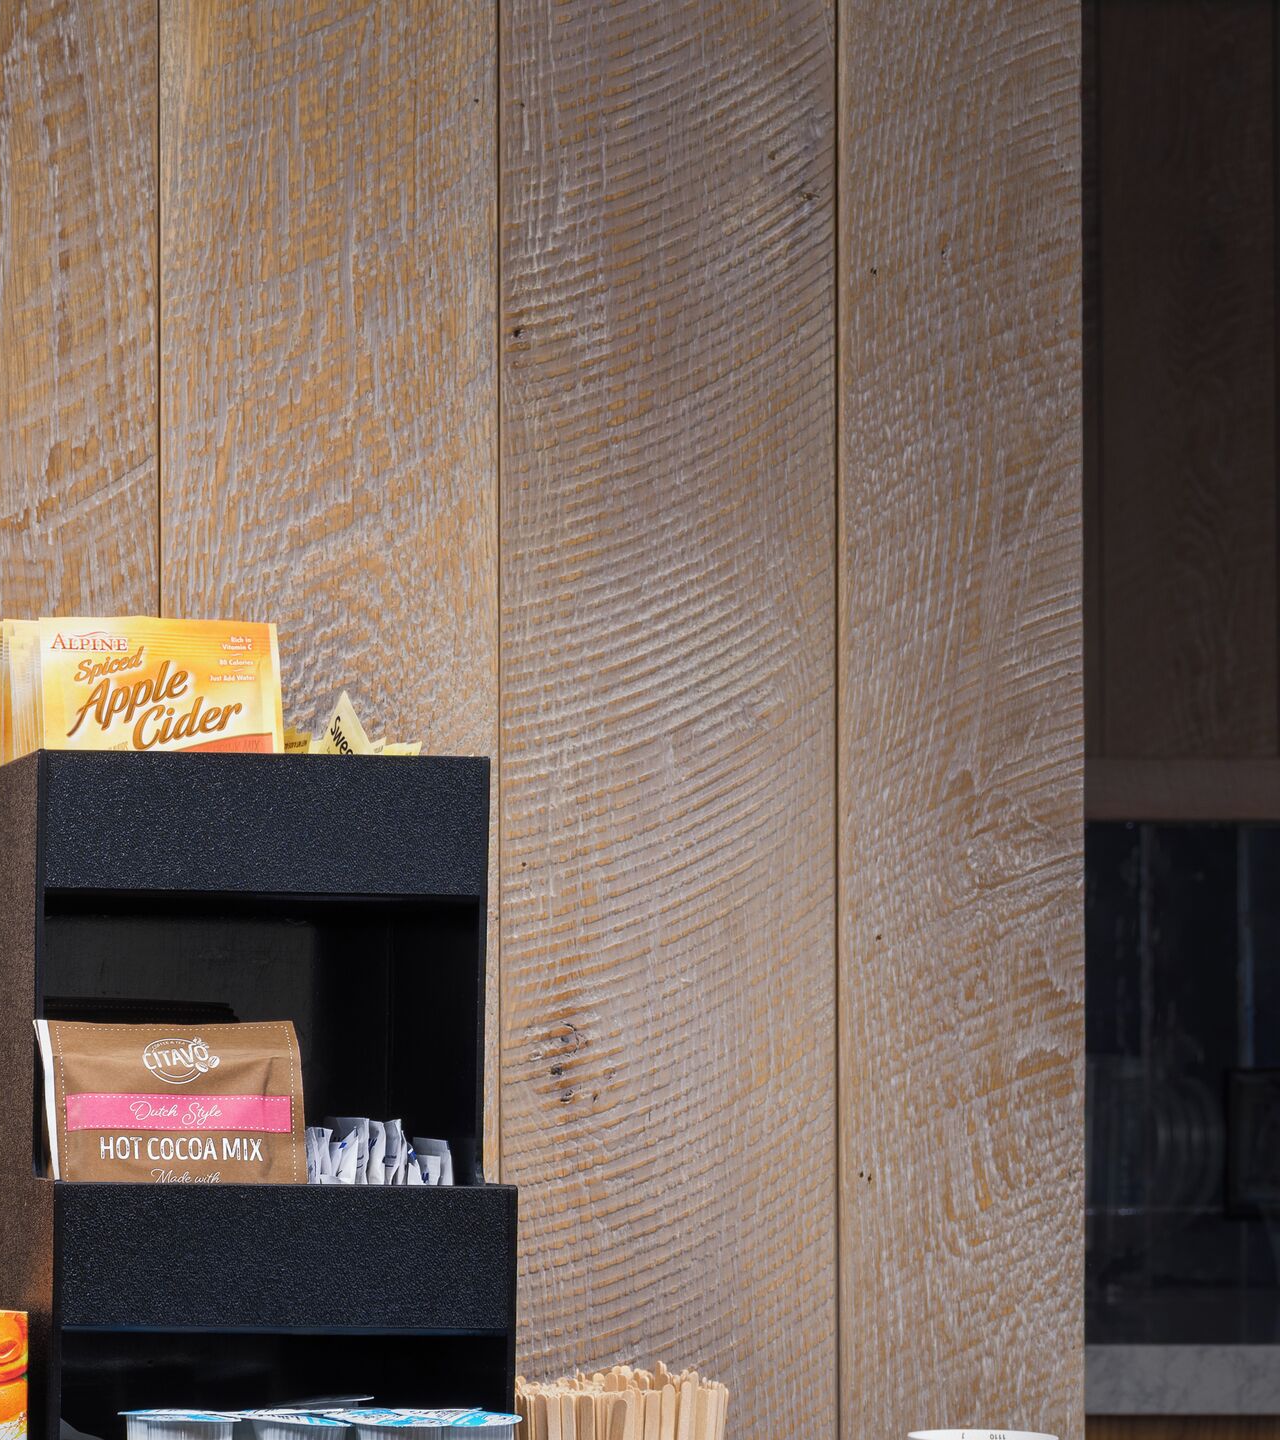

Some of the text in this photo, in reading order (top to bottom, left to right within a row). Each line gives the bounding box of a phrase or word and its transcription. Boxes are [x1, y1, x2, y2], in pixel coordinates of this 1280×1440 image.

[50, 633, 128, 651] ALPINE
[74, 646, 144, 684] Spiced
[66, 660, 189, 737] Apple
[133, 696, 242, 750] Cider
[142, 1044, 208, 1069] CITAVO
[130, 1101, 222, 1125] Dutch Style
[99, 1136, 263, 1161] HOT COCOA MIX
[151, 1169, 221, 1183] Made with
